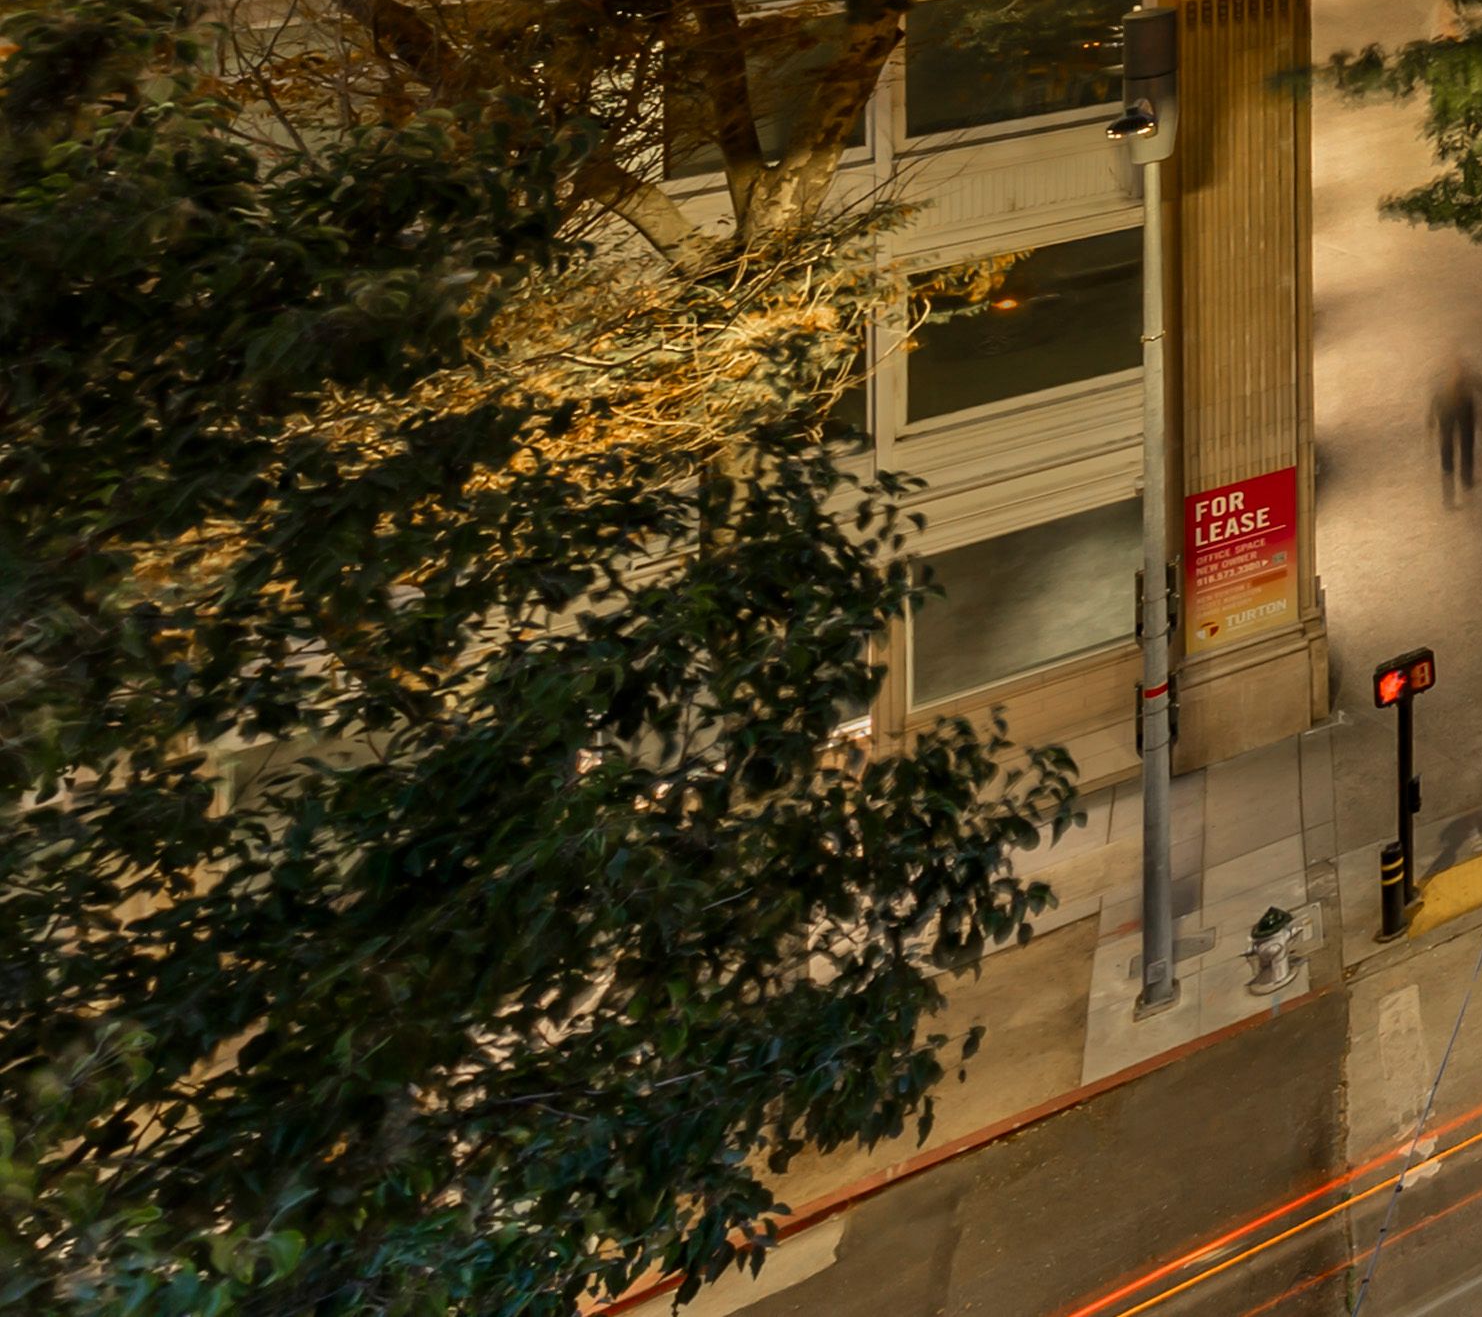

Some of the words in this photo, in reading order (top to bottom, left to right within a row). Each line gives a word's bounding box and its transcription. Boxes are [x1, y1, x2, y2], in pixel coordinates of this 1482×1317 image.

[1195, 491, 1245, 523] FOR
[1195, 507, 1270, 547] LEASE
[1196, 548, 1231, 566] OFFICE
[1234, 537, 1266, 555] SPACE
[1196, 563, 1219, 577] NEW
[1221, 551, 1258, 569] OWNER
[1226, 598, 1287, 626] TURTON
